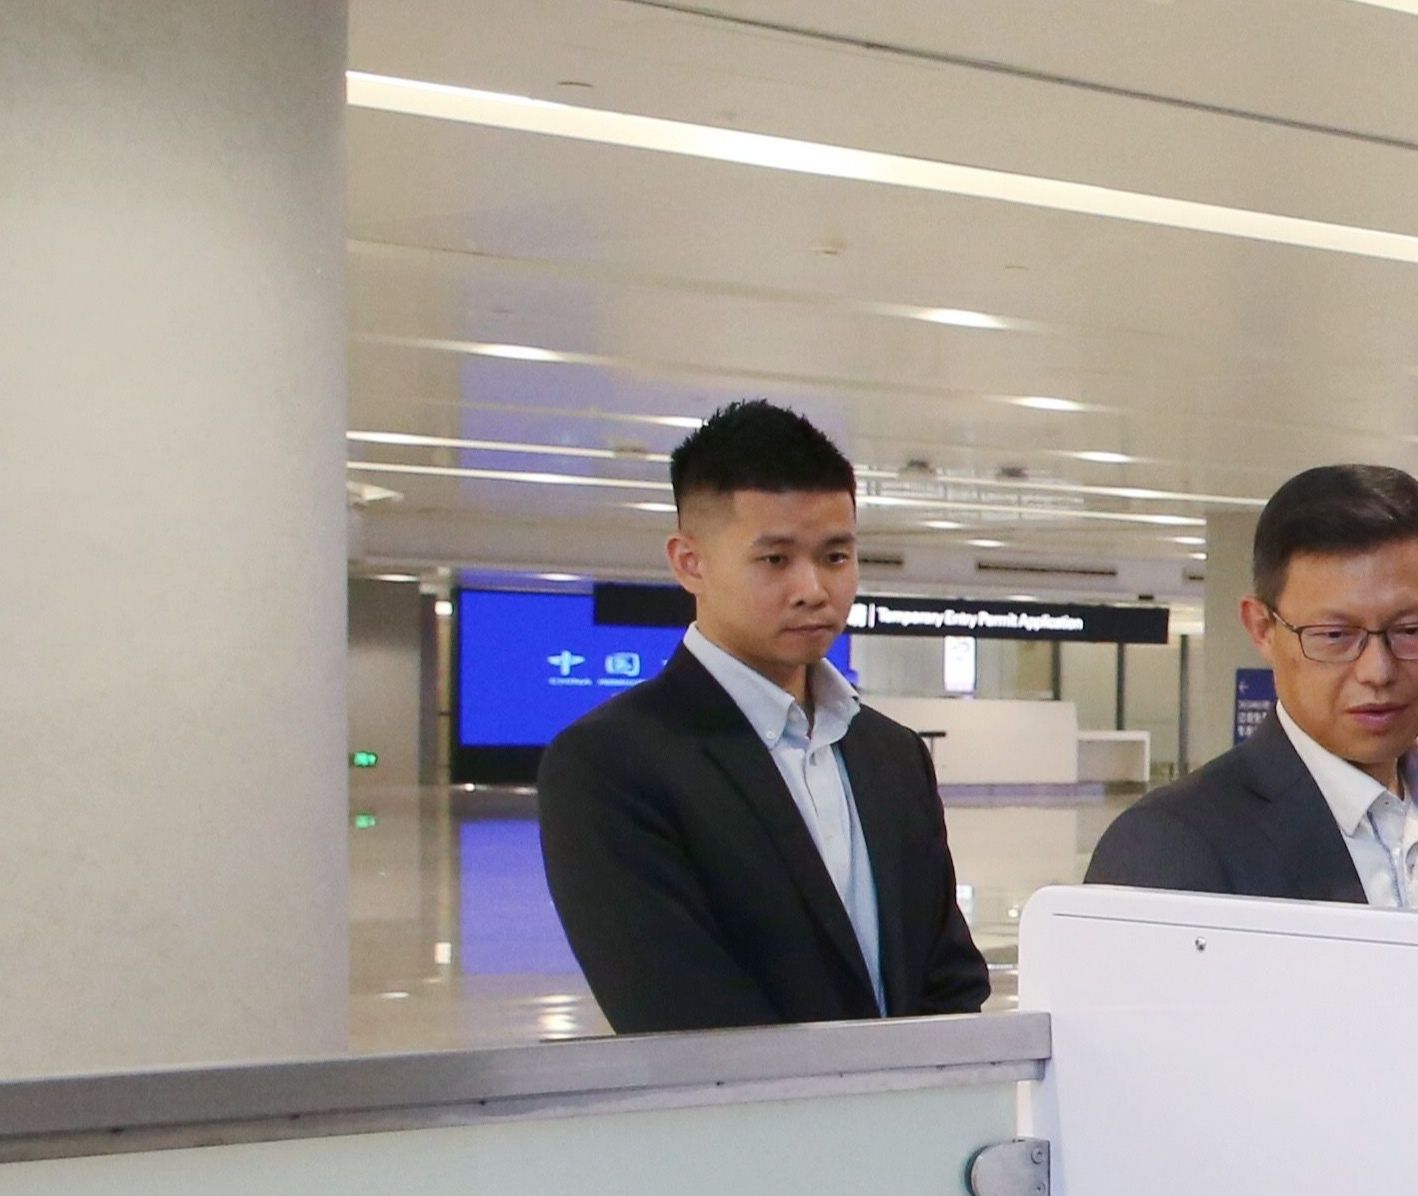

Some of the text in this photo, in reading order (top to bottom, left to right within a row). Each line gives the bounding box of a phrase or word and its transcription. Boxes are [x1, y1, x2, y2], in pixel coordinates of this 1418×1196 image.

[876, 607, 944, 628] Temporary
[944, 609, 976, 629] Entry
[978, 610, 1018, 629] Permit
[1018, 612, 1084, 632] Application
